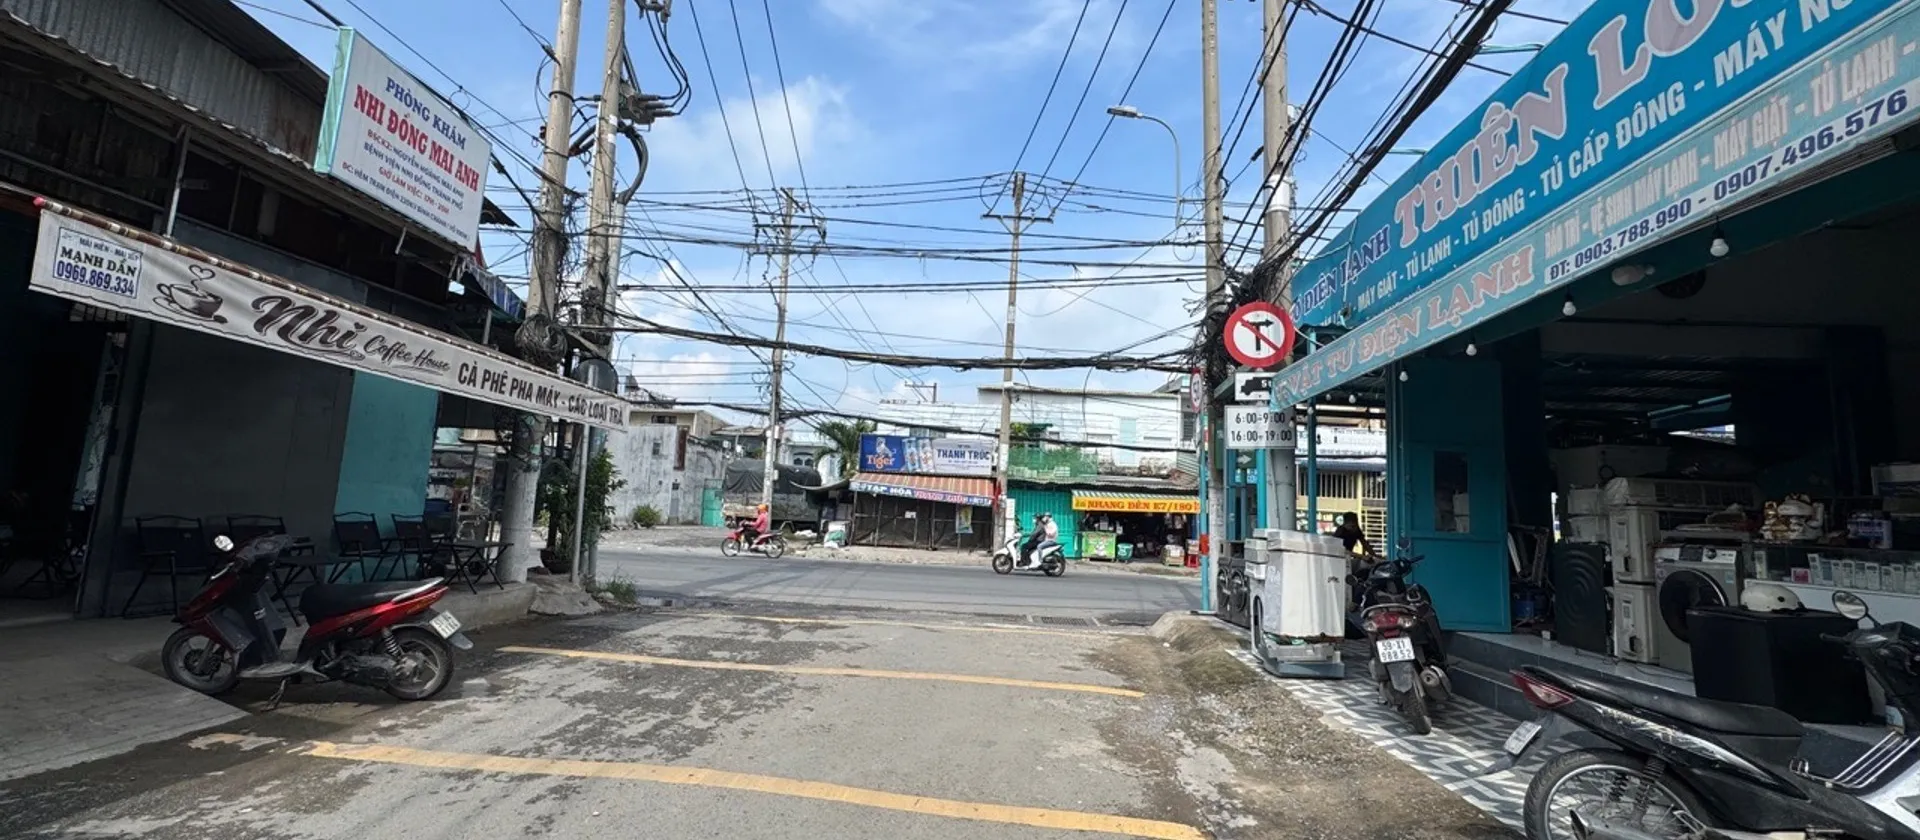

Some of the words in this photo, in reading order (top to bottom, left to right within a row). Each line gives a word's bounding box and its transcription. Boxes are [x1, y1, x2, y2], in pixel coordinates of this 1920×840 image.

[354, 84, 386, 125] NHI
[387, 108, 429, 155] ĐỒNG
[429, 140, 455, 175] MAI
[455, 160, 480, 192] ANH
[386, 76, 431, 122] PHÒNG
[432, 114, 467, 150] KHÁM
[1358, 285, 1376, 312] MÁY
[1377, 270, 1398, 299] GIẶT
[1405, 250, 1419, 280] TỦ
[1421, 235, 1451, 272] LẠNH
[1462, 210, 1479, 245] TỦ
[1483, 187, 1525, 234] ĐÔNG
[1540, 154, 1563, 196] TỦ
[1568, 128, 1610, 179] CẤP
[1615, 80, 1686, 150] ĐÔNG
[1713, 8, 1787, 88] MÁY
[1605, 184, 1633, 228] SINH
[1634, 167, 1662, 213] MÁY
[1664, 147, 1698, 199] LẠNH
[1713, 116, 1748, 171] MÁY
[1752, 93, 1789, 148] GIẶT
[1810, 60, 1835, 117] TỦ
[1840, 33, 1896, 104] LẠNH
[1304, 267, 1337, 316] ĐIỆN
[1340, 224, 1390, 287] LẠNH
[1394, 63, 1568, 248] THIÊN
[1550, 259, 1571, 280] ĐT:
[1575, 198, 1692, 269] 0903.788.990
[1713, 89, 1908, 201] 0907.496.576
[57, 260, 135, 295] 0969.869.334
[61, 246, 105, 268] MẠNH
[251, 295, 367, 355] Nhi
[363, 334, 413, 365] Coffee
[413, 348, 452, 371] House
[458, 360, 477, 388] CÀ
[481, 369, 508, 396] PHÊ
[509, 377, 533, 402] PHA
[535, 385, 561, 409] MÁY
[1327, 340, 1356, 379] TƯ
[1358, 307, 1421, 364] ĐIỆN
[1428, 244, 1535, 330] LẠNH
[867, 454, 896, 469] Tiger
[937, 448, 966, 459] THANH
[967, 448, 990, 461] TRÚC
[1088, 500, 1124, 509] NHANG
[1128, 499, 1151, 510] ĐÈN
